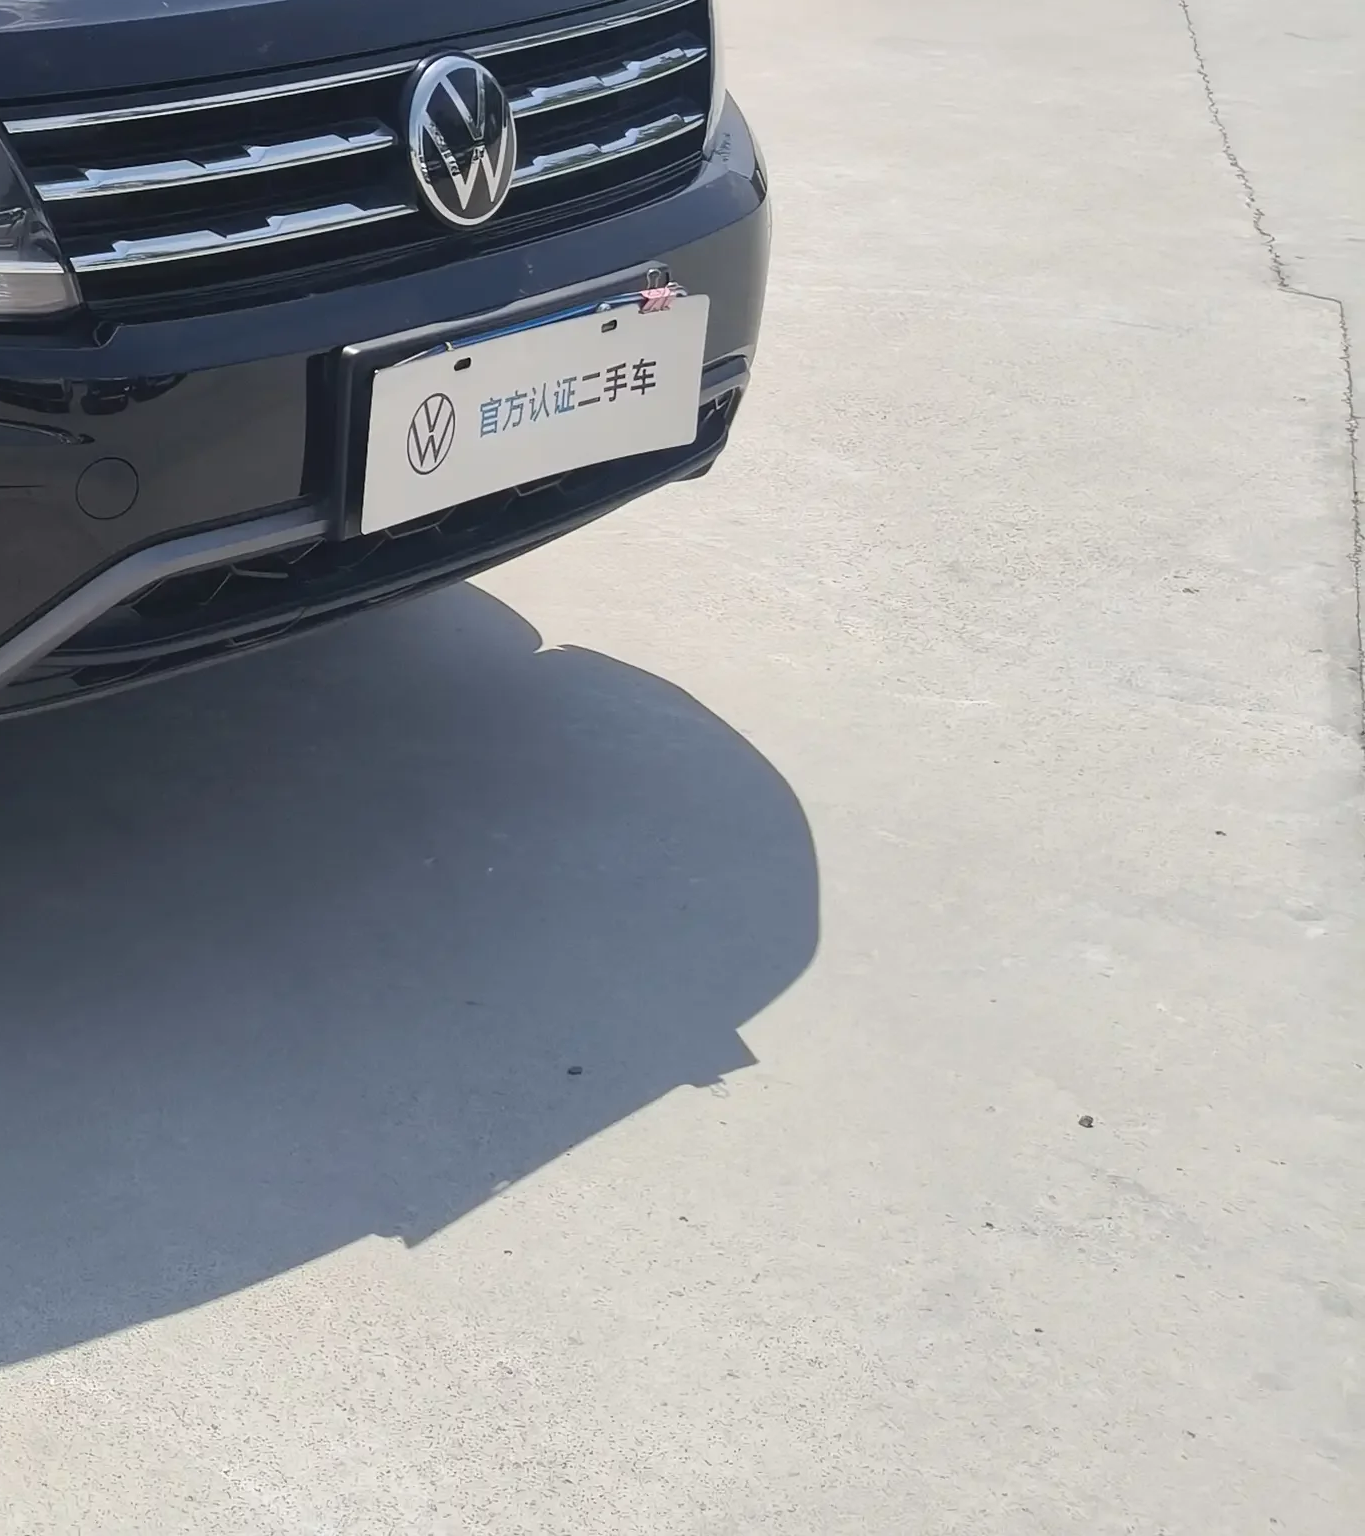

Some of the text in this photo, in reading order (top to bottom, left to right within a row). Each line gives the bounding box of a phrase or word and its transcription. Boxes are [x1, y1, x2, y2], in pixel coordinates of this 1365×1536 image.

[478, 357, 657, 439] 官方认证二手车
